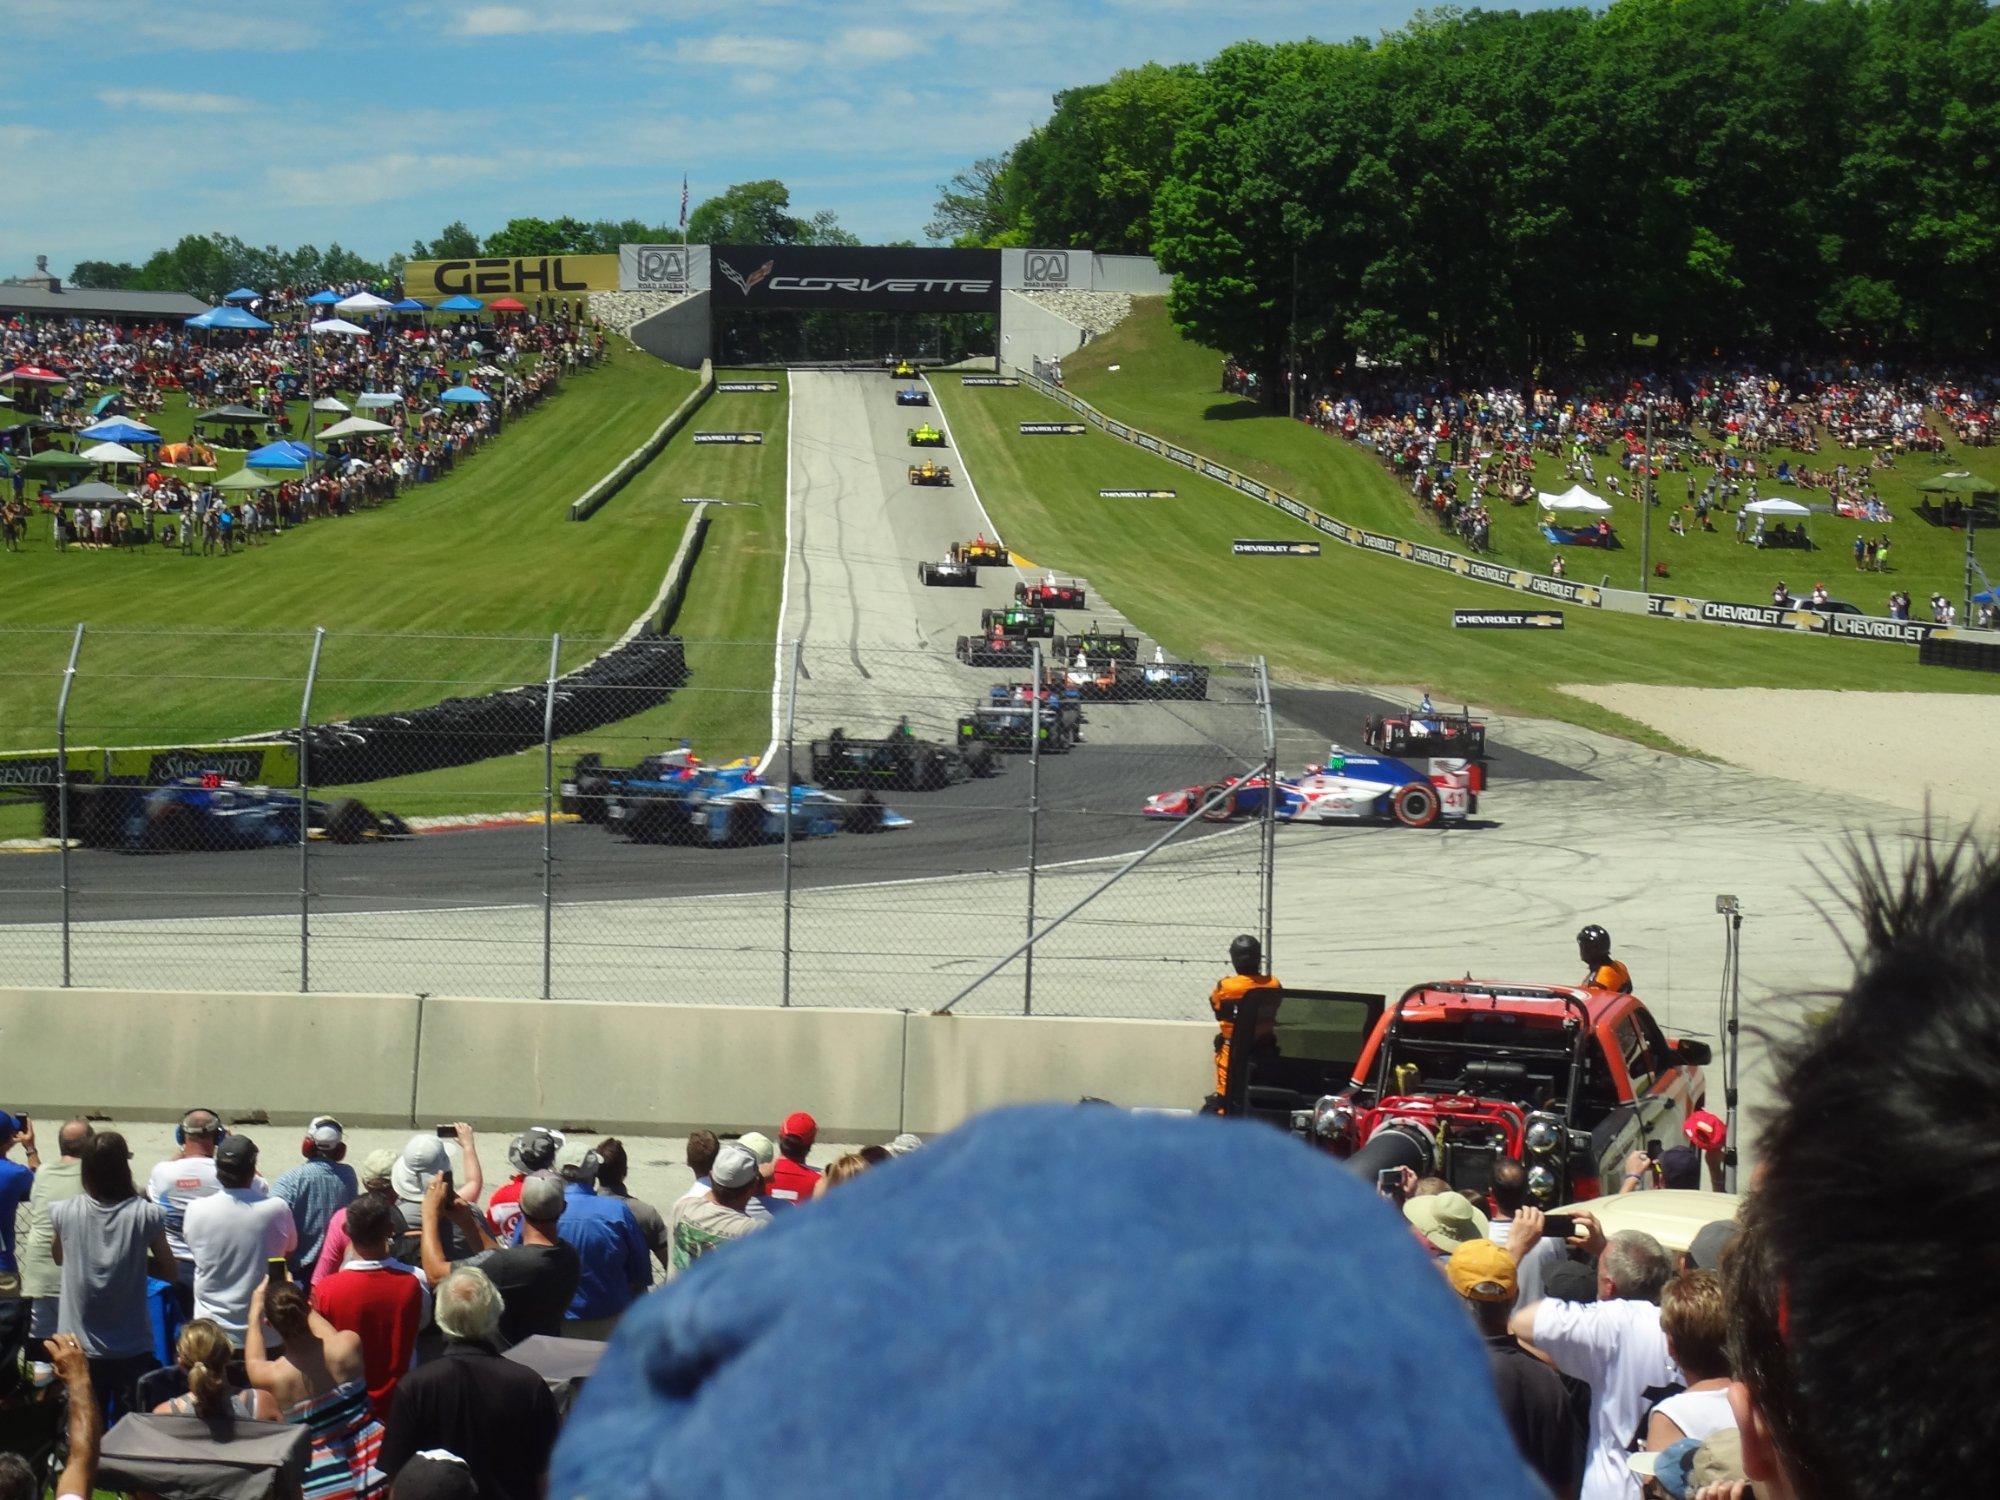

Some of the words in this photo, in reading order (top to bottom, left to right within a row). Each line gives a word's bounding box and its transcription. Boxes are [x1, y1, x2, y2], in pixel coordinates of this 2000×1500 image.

[433, 258, 588, 294] GEHL
[769, 276, 994, 294] CORVETTE
[1234, 544, 1288, 552] CHEVROLET
[1363, 535, 1396, 551] CHEVROLET
[1416, 548, 1450, 568] CHEVROLET
[1471, 564, 1510, 583] CHEVROLET
[1532, 578, 1576, 599] CHEVROLET
[1455, 615, 1524, 624] CHEVROLET
[1704, 604, 1781, 625] CHEVROLET
[1394, 728, 1405, 738] 14
[1445, 791, 1464, 807] 41
